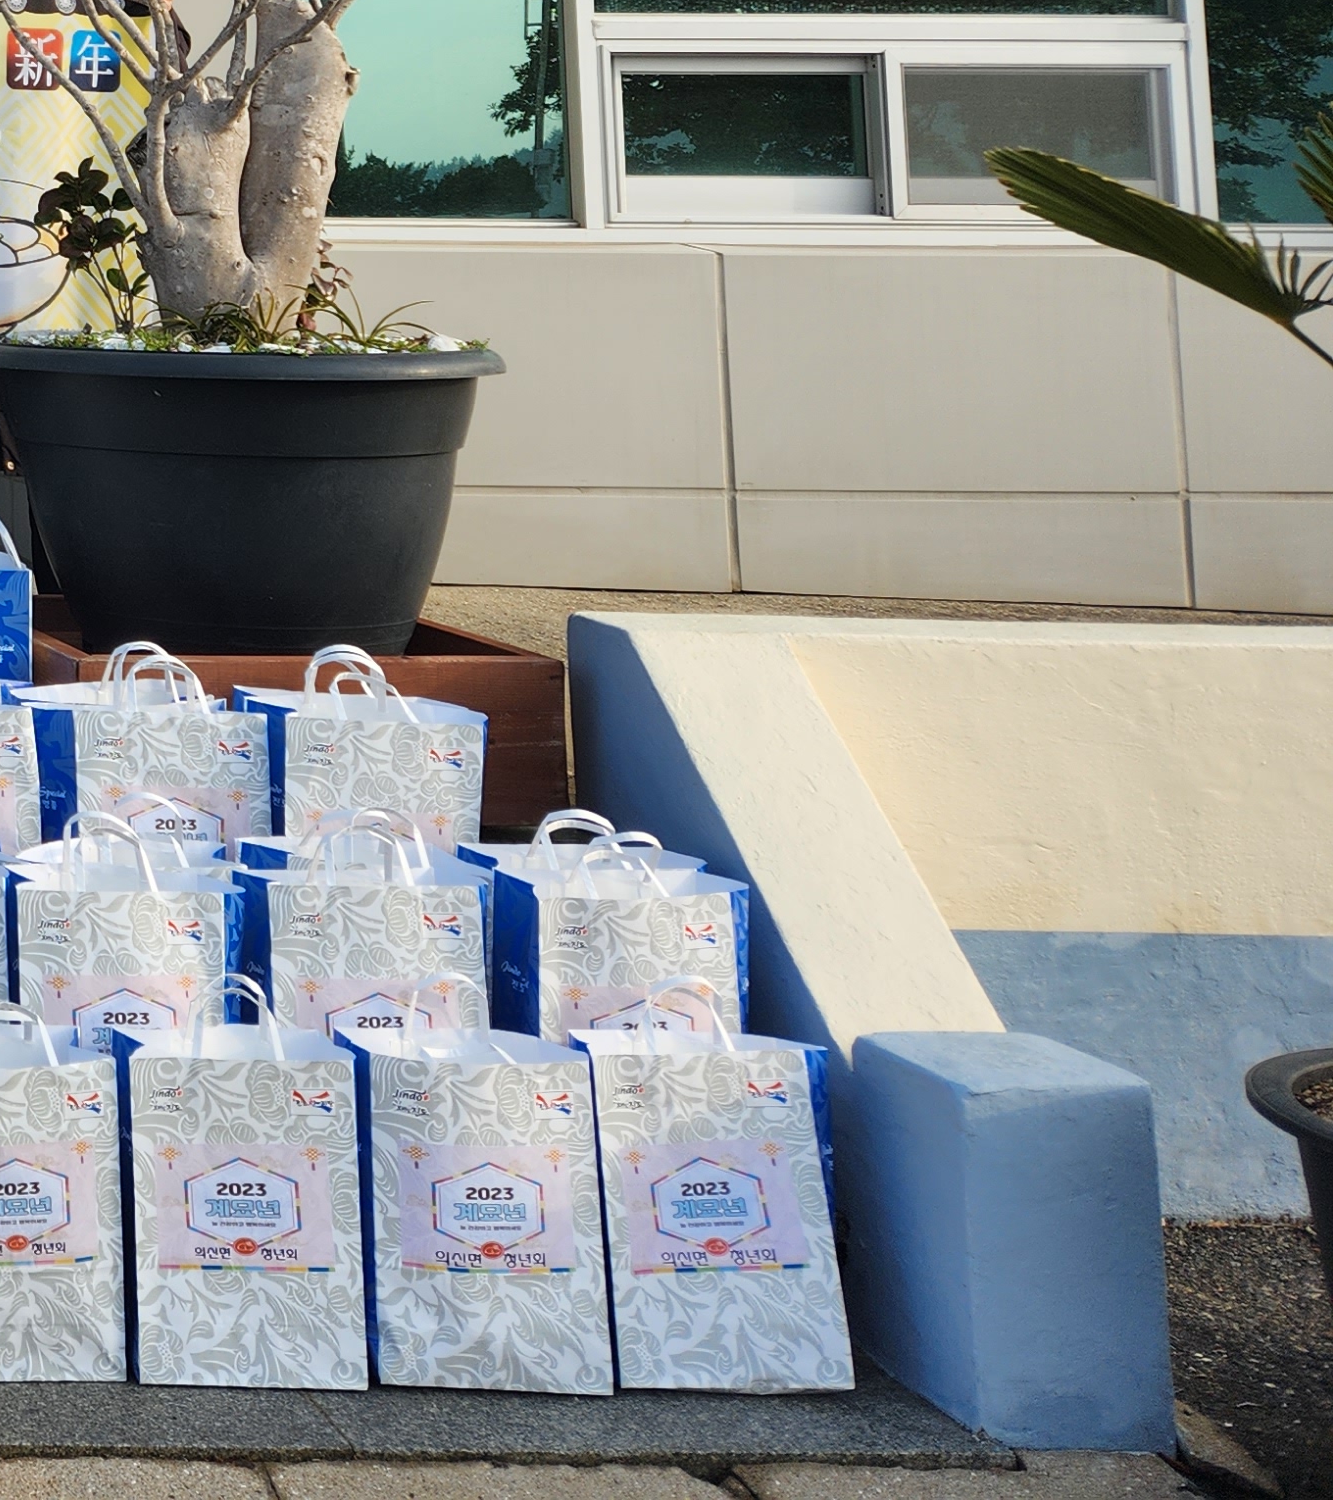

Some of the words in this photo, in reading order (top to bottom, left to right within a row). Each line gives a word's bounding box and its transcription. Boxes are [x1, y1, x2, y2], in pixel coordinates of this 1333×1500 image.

[101, 1011, 148, 1026] 2023
[354, 1016, 404, 1029] 2023
[150, 1088, 177, 1099] Jindo
[392, 1088, 423, 1101] Jindo
[216, 1183, 267, 1197] 2023
[465, 1187, 515, 1201] 2023
[680, 1182, 731, 1197] 2023
[205, 1199, 281, 1219] 계묘년
[454, 1203, 527, 1222] 계묘년
[671, 1198, 748, 1219] 계묘년
[435, 1251, 482, 1268] 의신면
[503, 1252, 546, 1268] 청년회
[661, 1251, 708, 1267] 의신면
[730, 1249, 777, 1264] 청년회
